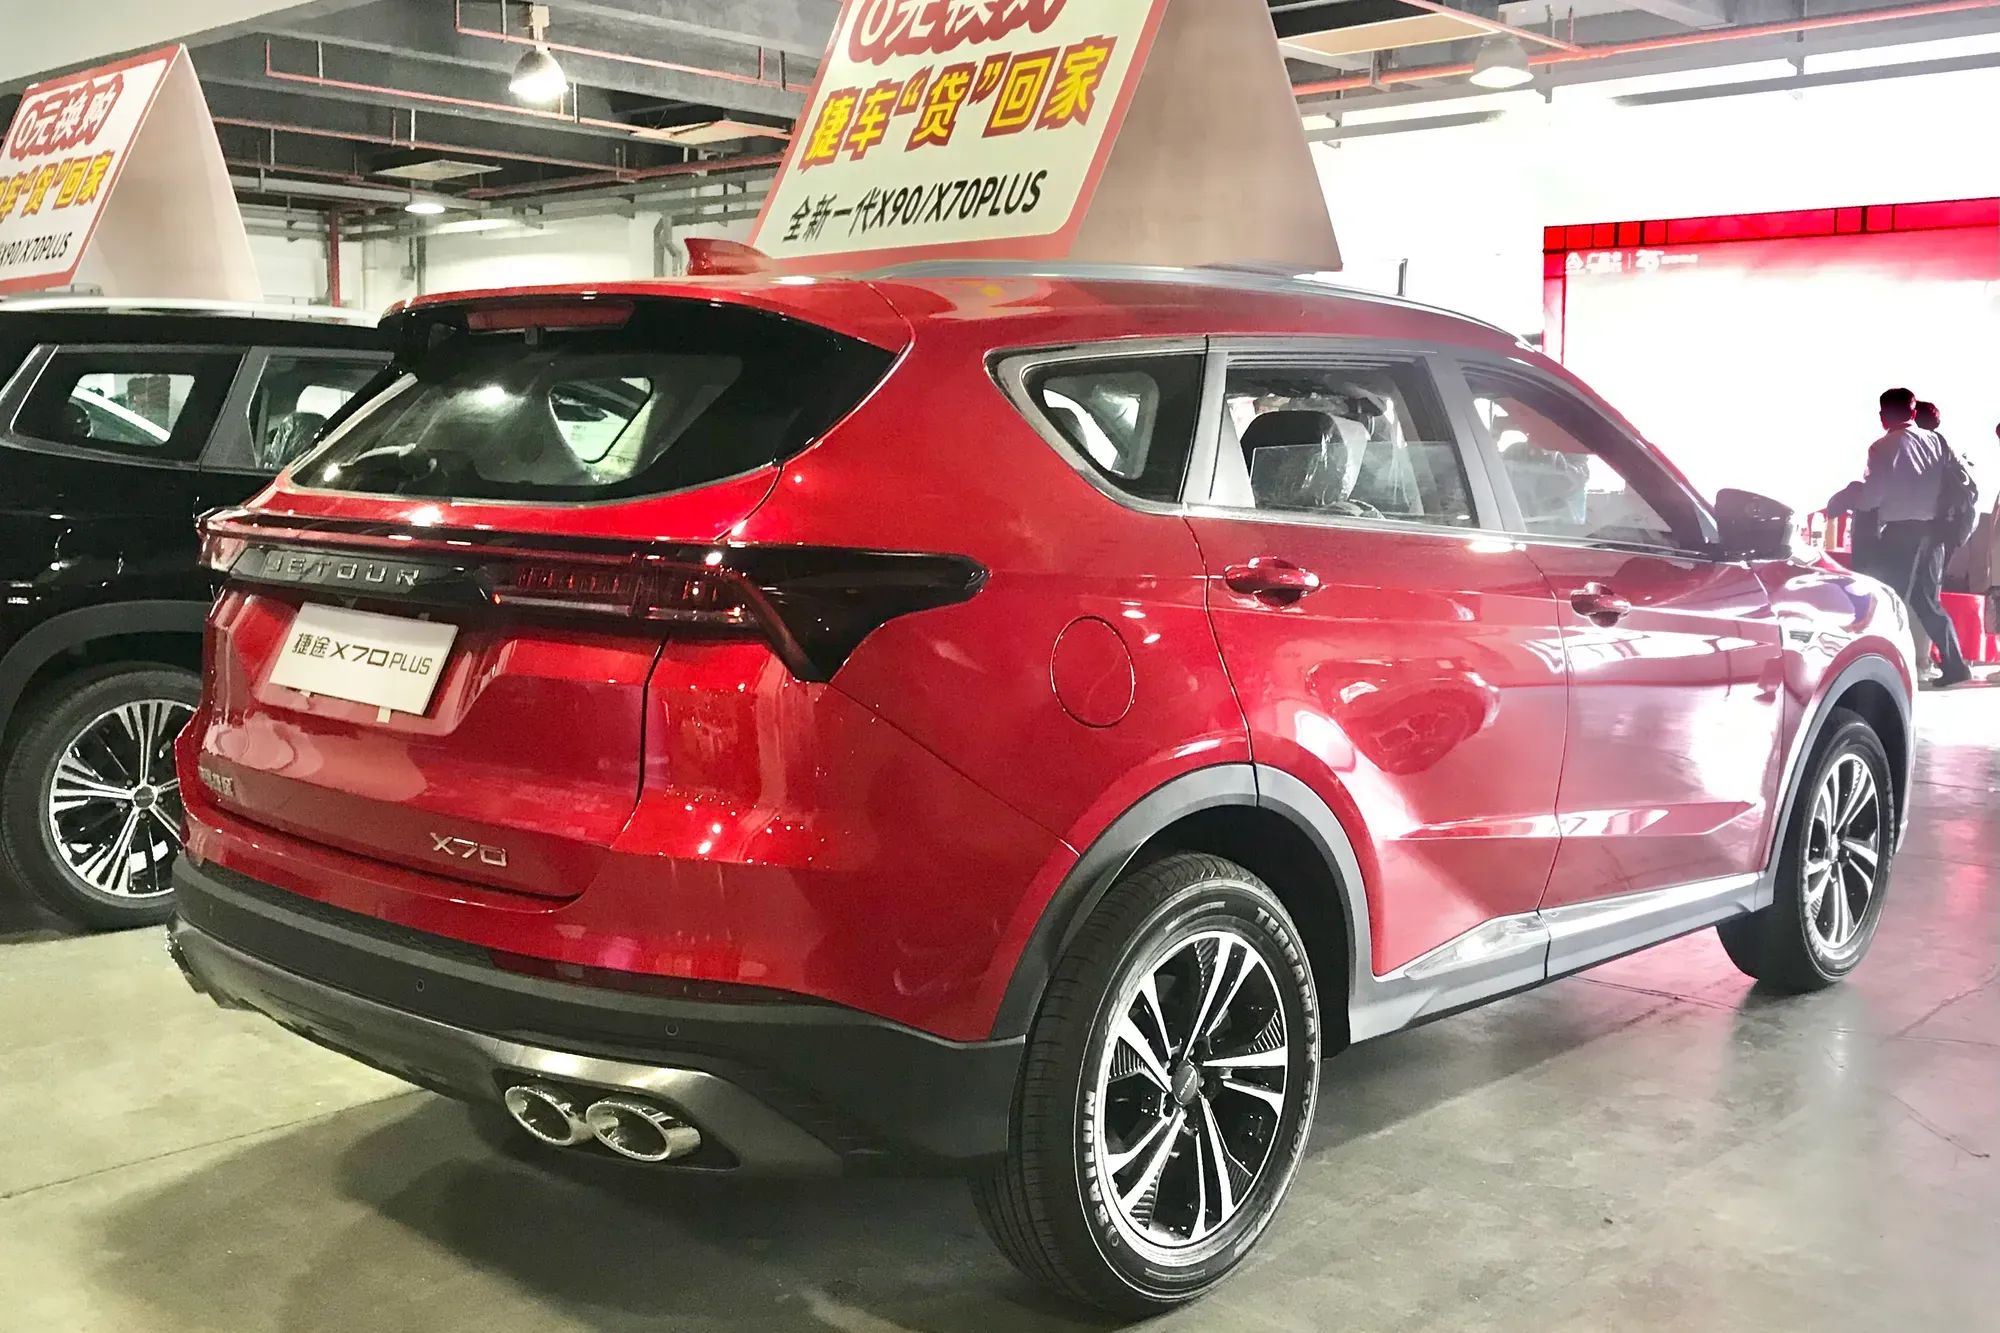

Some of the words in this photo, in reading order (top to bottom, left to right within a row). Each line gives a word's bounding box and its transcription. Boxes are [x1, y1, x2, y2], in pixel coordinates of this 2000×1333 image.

[782, 169, 1048, 243] 全新一代X90/X70PLUS
[264, 555, 420, 587] JETOUR
[429, 831, 508, 868] X70
[1256, 905, 1317, 1064] TERRAMAX
[1083, 1089, 1110, 1228] SAILUN
